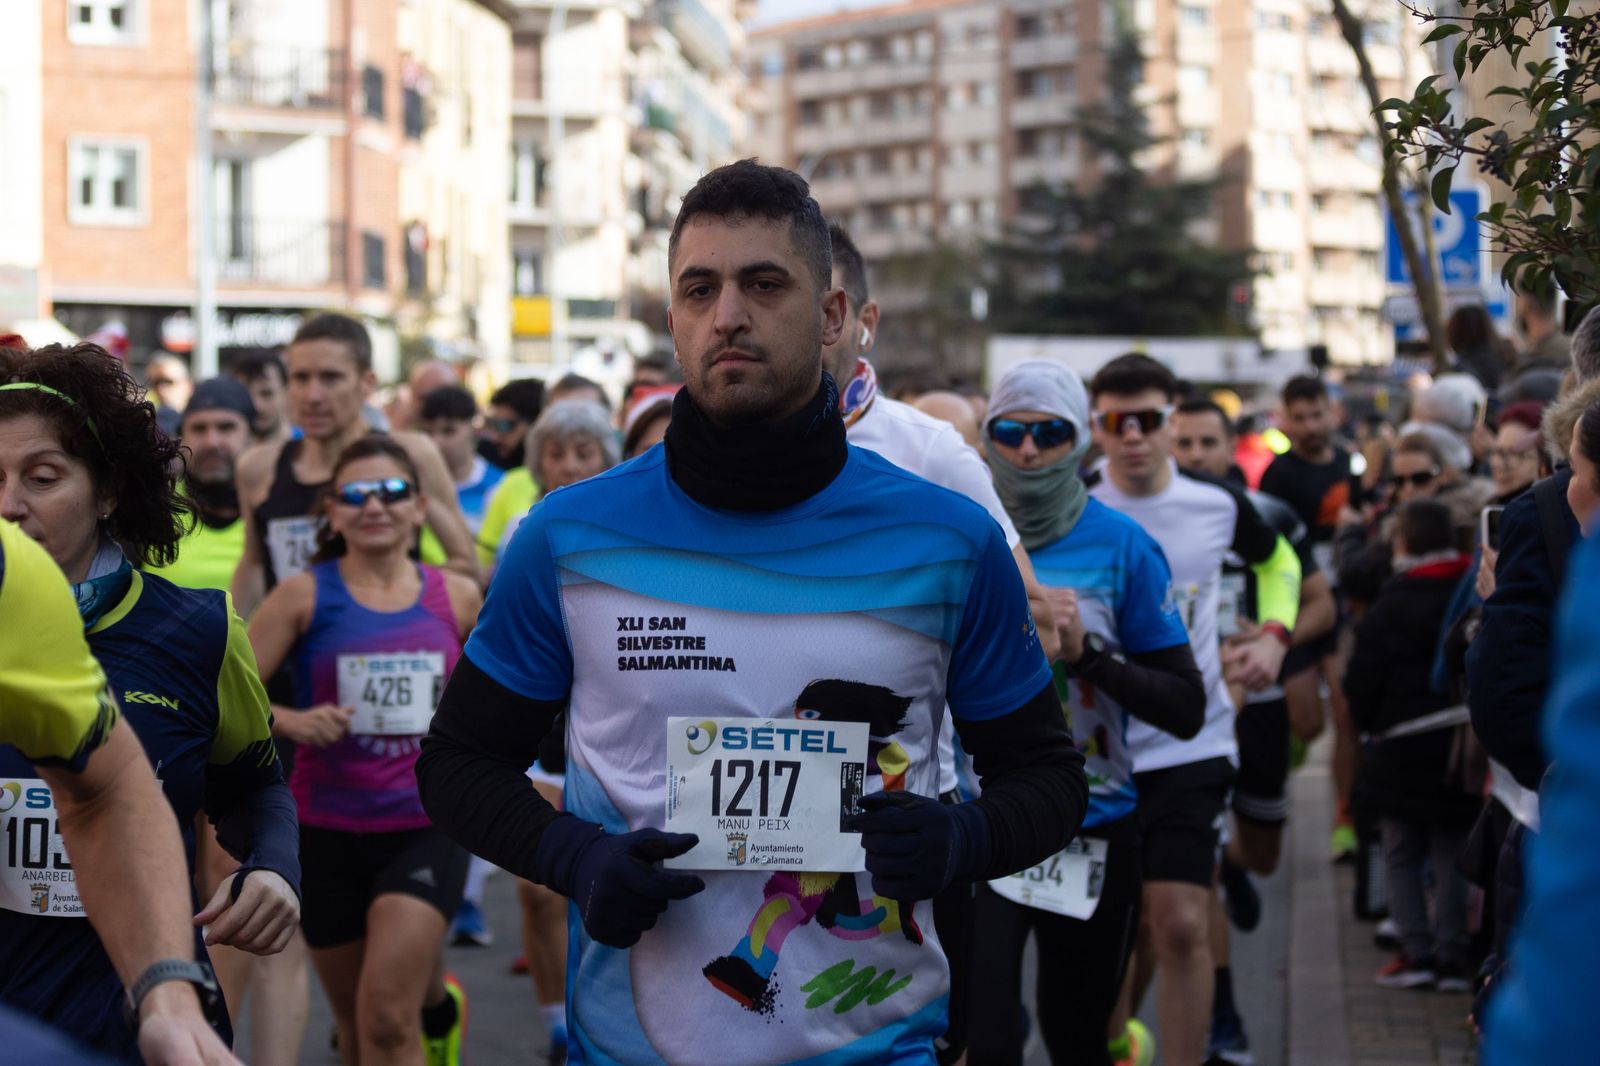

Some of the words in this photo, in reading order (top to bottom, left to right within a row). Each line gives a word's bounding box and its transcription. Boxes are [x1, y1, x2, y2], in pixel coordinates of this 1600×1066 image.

[617, 616, 644, 631] XLI
[648, 616, 686, 631] SAN
[617, 635, 706, 651] SILVESTRE
[368, 660, 432, 672] SETEL
[617, 656, 736, 672] SALMANTINA
[361, 676, 412, 707] 426
[722, 726, 847, 754] SETEL
[710, 759, 801, 817] 1217
[25, 787, 57, 809] S
[717, 819, 750, 830] MANU
[758, 819, 790, 831] PEIX
[750, 843, 804, 854] Ayuntamiento
[750, 855, 760, 864] de
[53, 894, 80, 903] Ayunta
[52, 904, 62, 913] de
